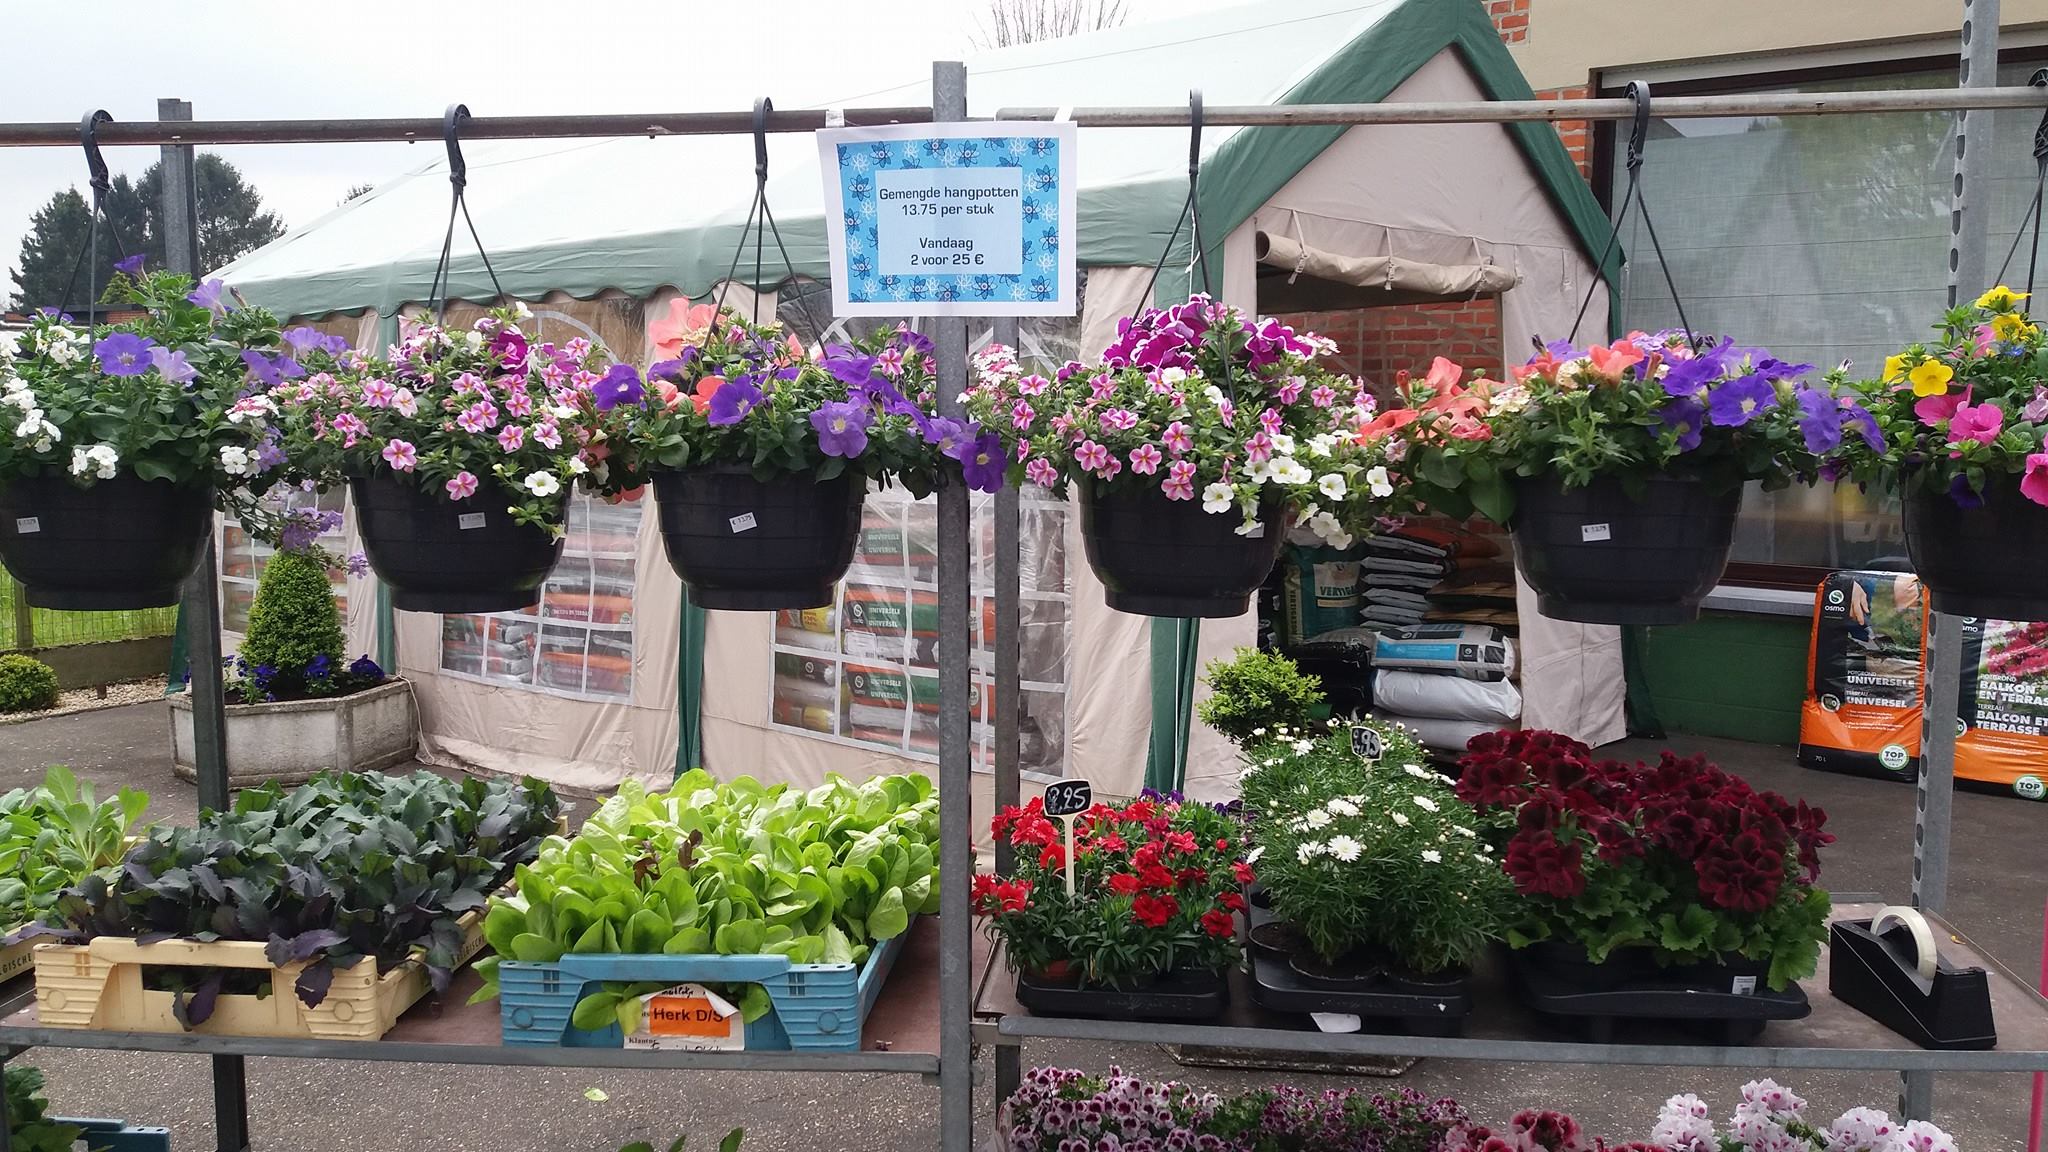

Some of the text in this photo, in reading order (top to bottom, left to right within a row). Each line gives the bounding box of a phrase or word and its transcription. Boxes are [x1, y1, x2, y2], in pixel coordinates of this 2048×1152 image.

[879, 186, 1019, 201] Gemengde hangpotten
[902, 203, 994, 217] 13.75 per stuk
[919, 237, 973, 251] Vandaag
[910, 254, 984, 265] 2 voor 25 €
[1847, 676, 1915, 688] UNIVERSELE
[1979, 681, 2036, 694] BALKON
[1846, 696, 1907, 708] UNIVERSEL
[1978, 690, 1998, 701] EN
[1977, 703, 2004, 711] TERREAU
[1977, 710, 2031, 725] BALCON
[1976, 720, 2040, 736] TERRASSE
[2019, 782, 2041, 790] TOP
[653, 1007, 691, 1021] Herk
